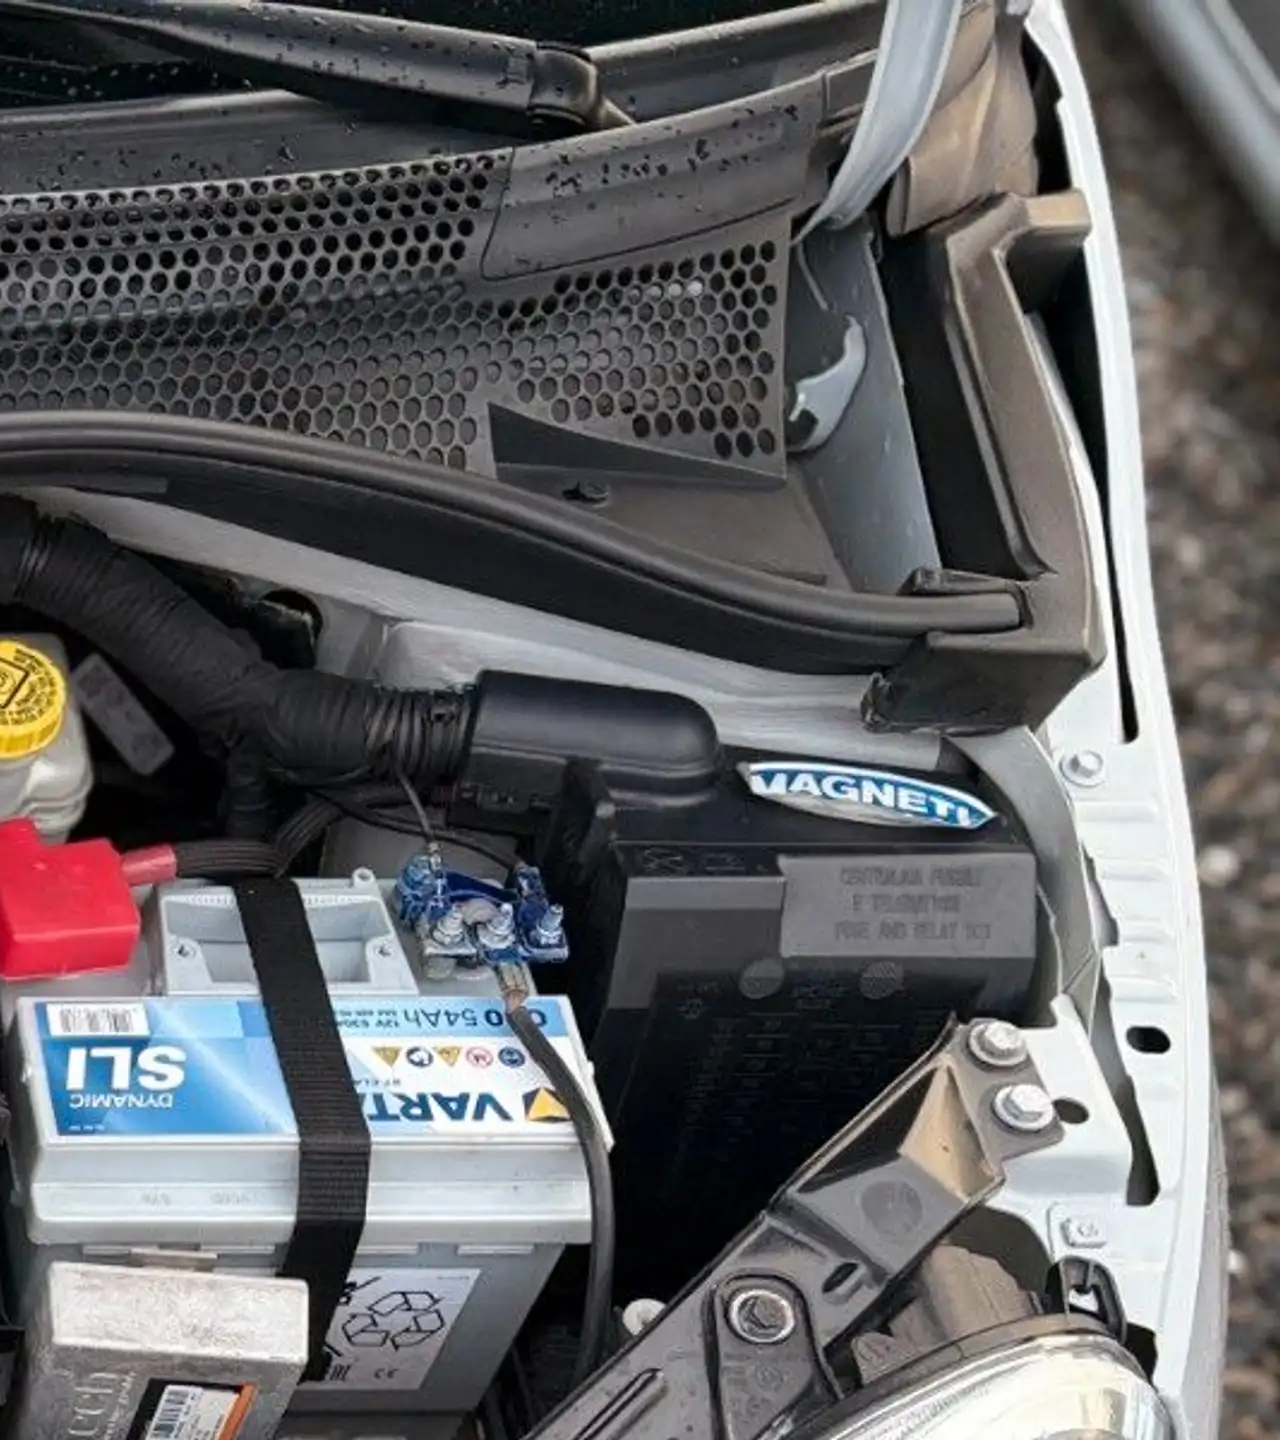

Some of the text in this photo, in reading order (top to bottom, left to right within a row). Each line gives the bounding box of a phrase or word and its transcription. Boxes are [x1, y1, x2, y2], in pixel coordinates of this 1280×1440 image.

[403, 1008, 478, 1028] 54Ah
[65, 1045, 187, 1092] SLI
[69, 1094, 173, 1108] DYNAMIC
[358, 1092, 514, 1122] VART
